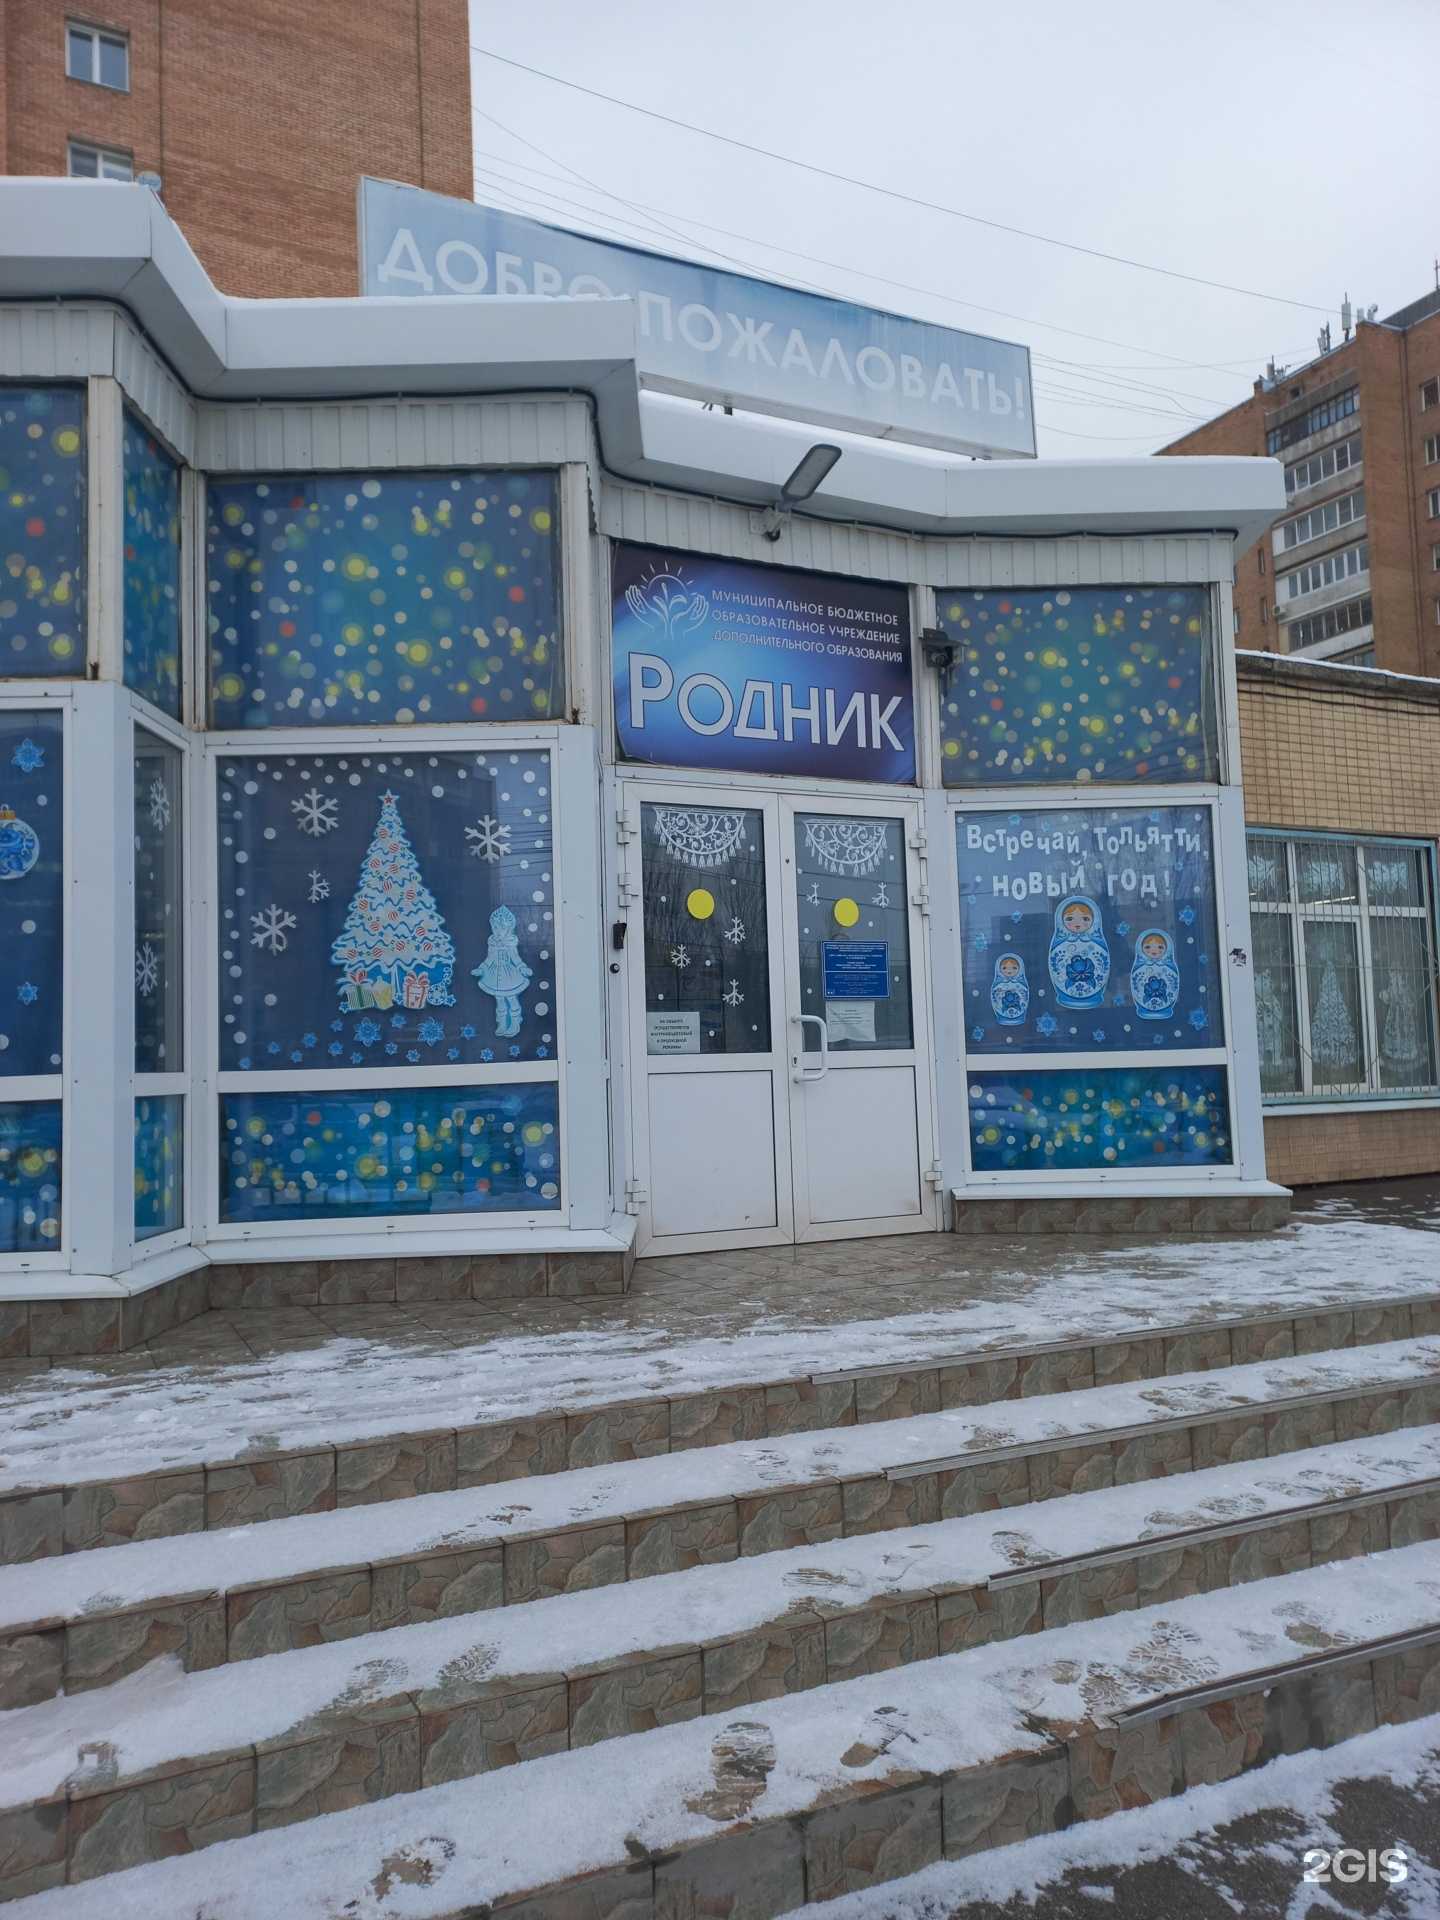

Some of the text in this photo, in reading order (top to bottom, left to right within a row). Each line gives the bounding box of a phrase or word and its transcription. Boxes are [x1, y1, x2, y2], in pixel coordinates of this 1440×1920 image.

[638, 294, 1026, 421] ПОЖАЛОВАТЬ!
[712, 590, 899, 626] МУНИЦИПАЛЬНОЕ БЮДЖЕТНОЕ
[711, 609, 901, 644] ОБРАЗОВАТЕЛЬНОЕ УЧРЕЖДЕНИЕ
[711, 630, 903, 663] ДОПОЛНИТЕЛЬНОГО ОБРАЗОВАНИЯ
[966, 824, 1088, 861] Встречай,
[1107, 868, 1171, 898] год!
